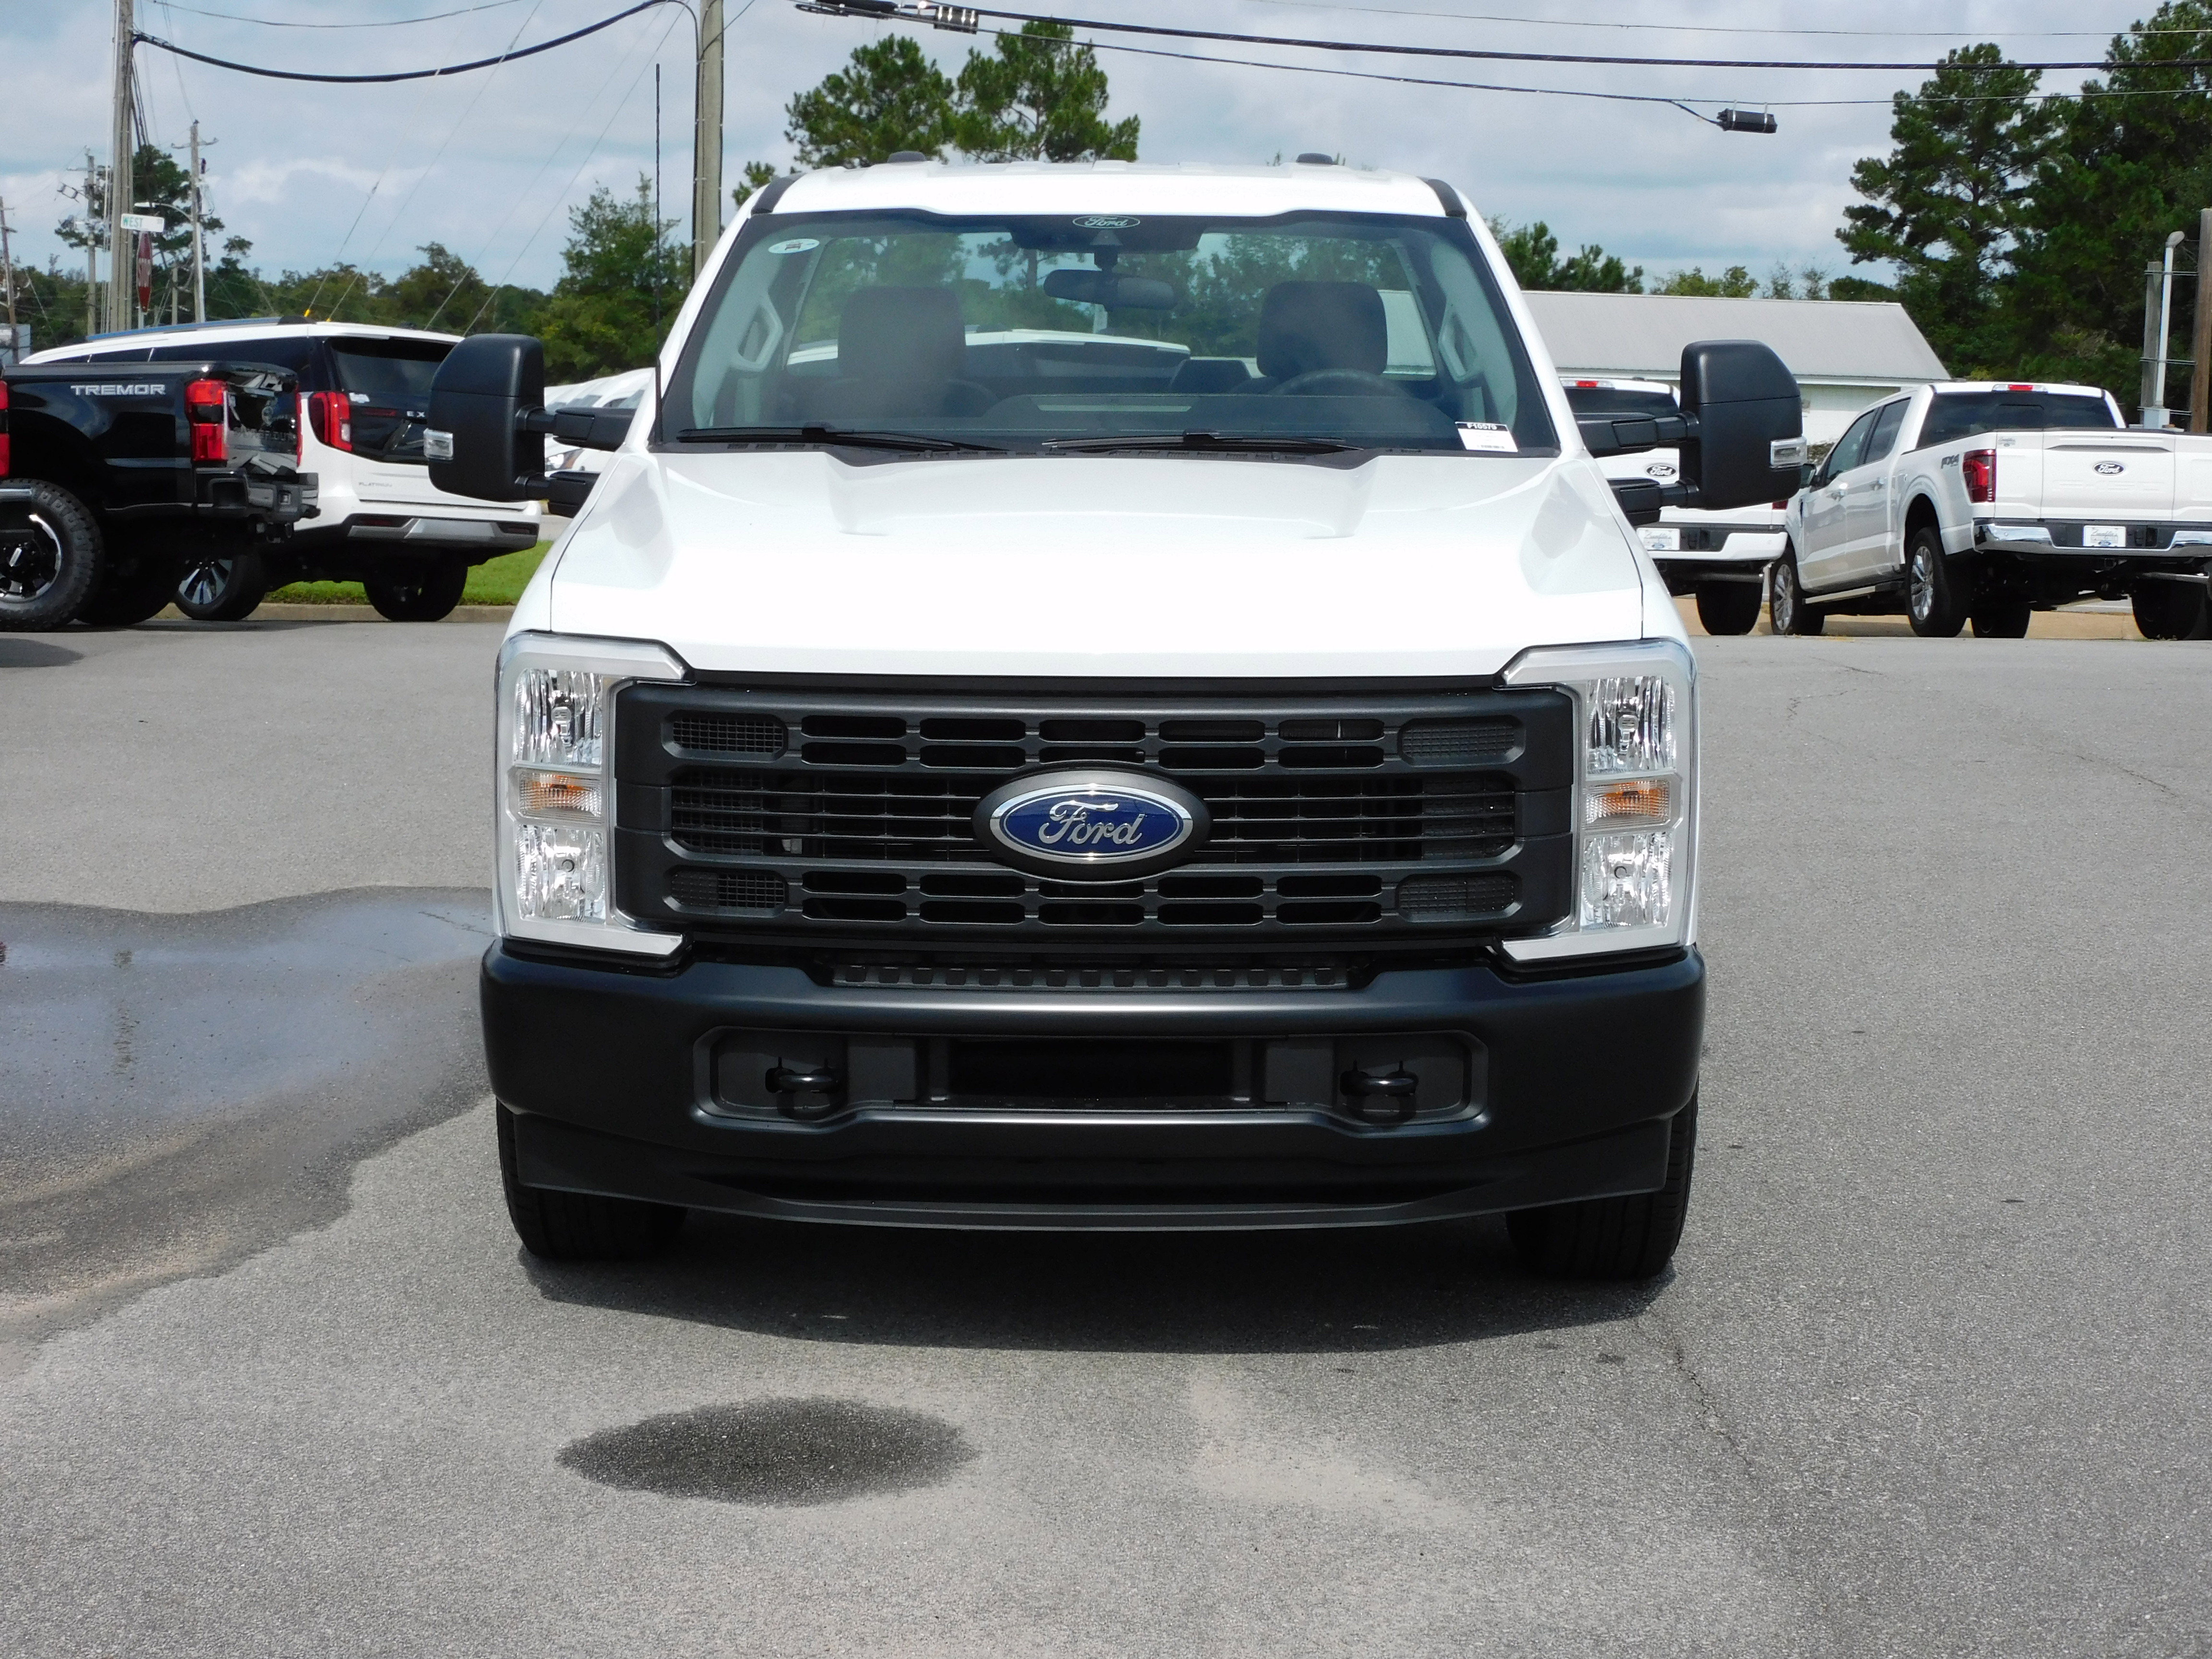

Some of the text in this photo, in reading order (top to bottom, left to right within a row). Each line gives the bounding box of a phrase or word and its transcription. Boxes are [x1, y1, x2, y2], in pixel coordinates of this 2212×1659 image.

[123, 216, 143, 228] WEST
[1084, 216, 1128, 226] Ford
[71, 385, 166, 396] TREMOR
[1650, 465, 1672, 475] Ford
[2098, 463, 2120, 473] Ford
[1038, 800, 1143, 845] Ford
